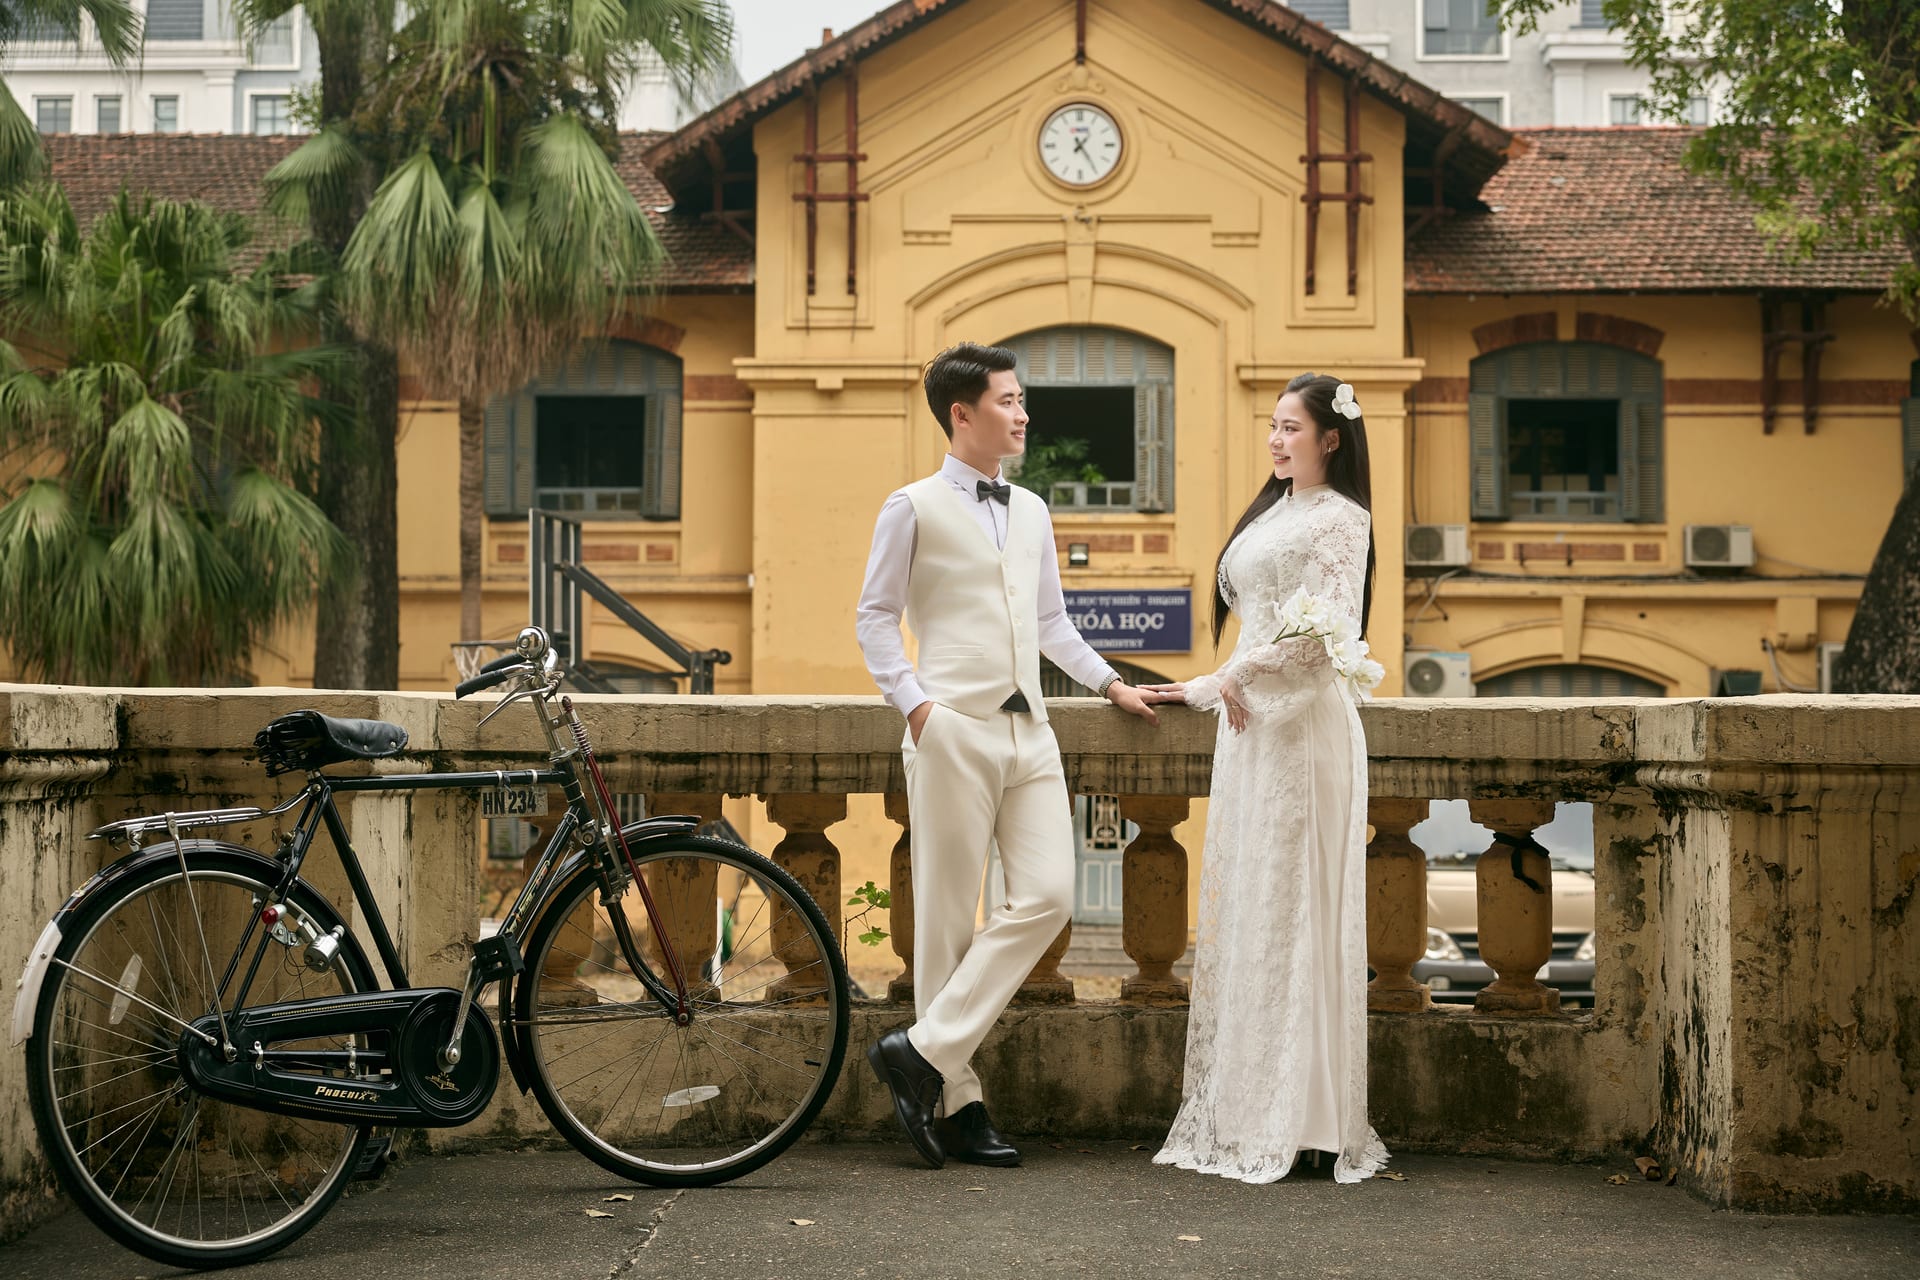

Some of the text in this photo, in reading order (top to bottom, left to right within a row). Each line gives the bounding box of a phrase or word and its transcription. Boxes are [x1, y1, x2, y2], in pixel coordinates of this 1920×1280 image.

[1118, 612, 1165, 633] HỌC
[482, 790, 537, 815] HN 234
